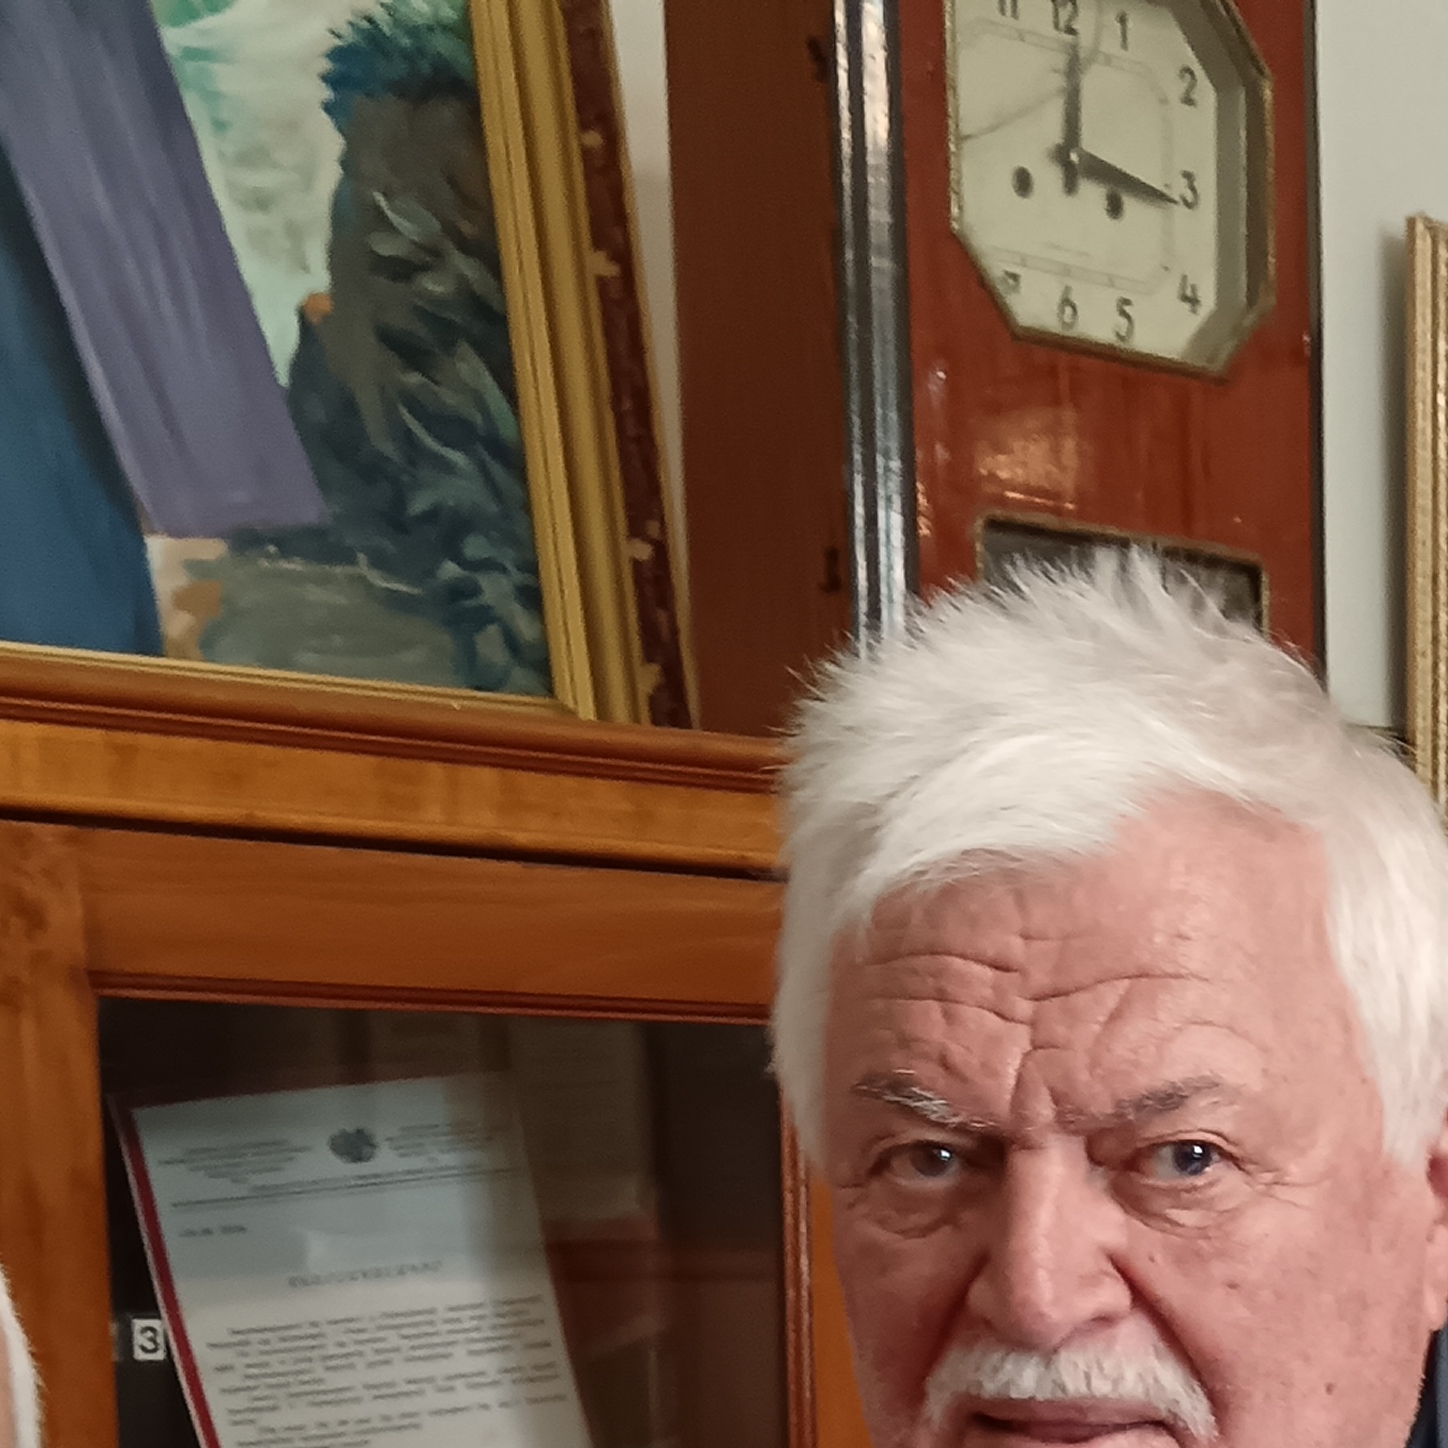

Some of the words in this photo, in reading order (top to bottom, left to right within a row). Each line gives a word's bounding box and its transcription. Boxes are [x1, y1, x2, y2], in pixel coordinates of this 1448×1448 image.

[1115, 10, 1129, 51] 1
[1177, 65, 1198, 107] 2
[1179, 170, 1199, 210] 3
[1057, 284, 1078, 331] 6
[1177, 273, 1201, 314] 4
[1114, 296, 1134, 342] 5
[139, 1326, 160, 1354] 3
